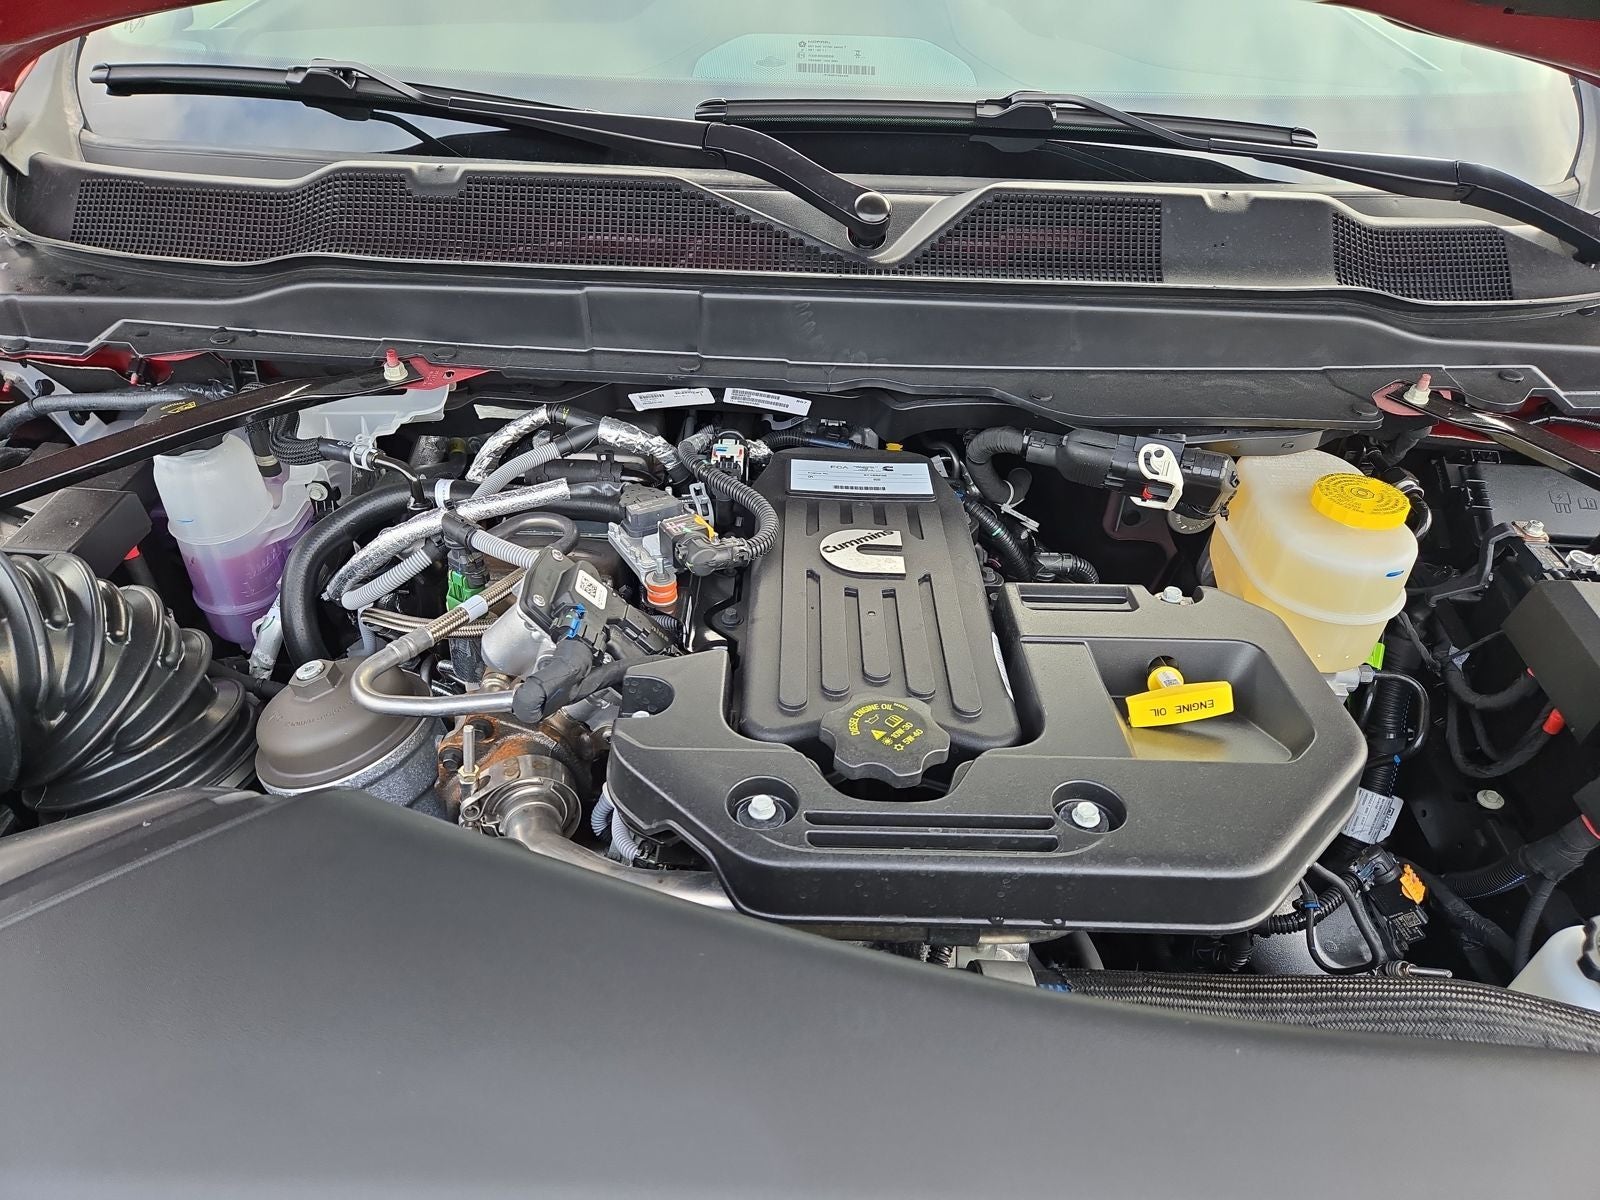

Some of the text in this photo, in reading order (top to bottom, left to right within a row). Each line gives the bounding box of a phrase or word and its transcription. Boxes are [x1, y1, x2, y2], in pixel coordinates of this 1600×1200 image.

[822, 529, 894, 553] Cummins
[853, 703, 880, 718] ENGINE
[880, 703, 894, 711] OIL
[1150, 699, 1215, 717] ENGINE OIL
[848, 717, 861, 736] DIESEL
